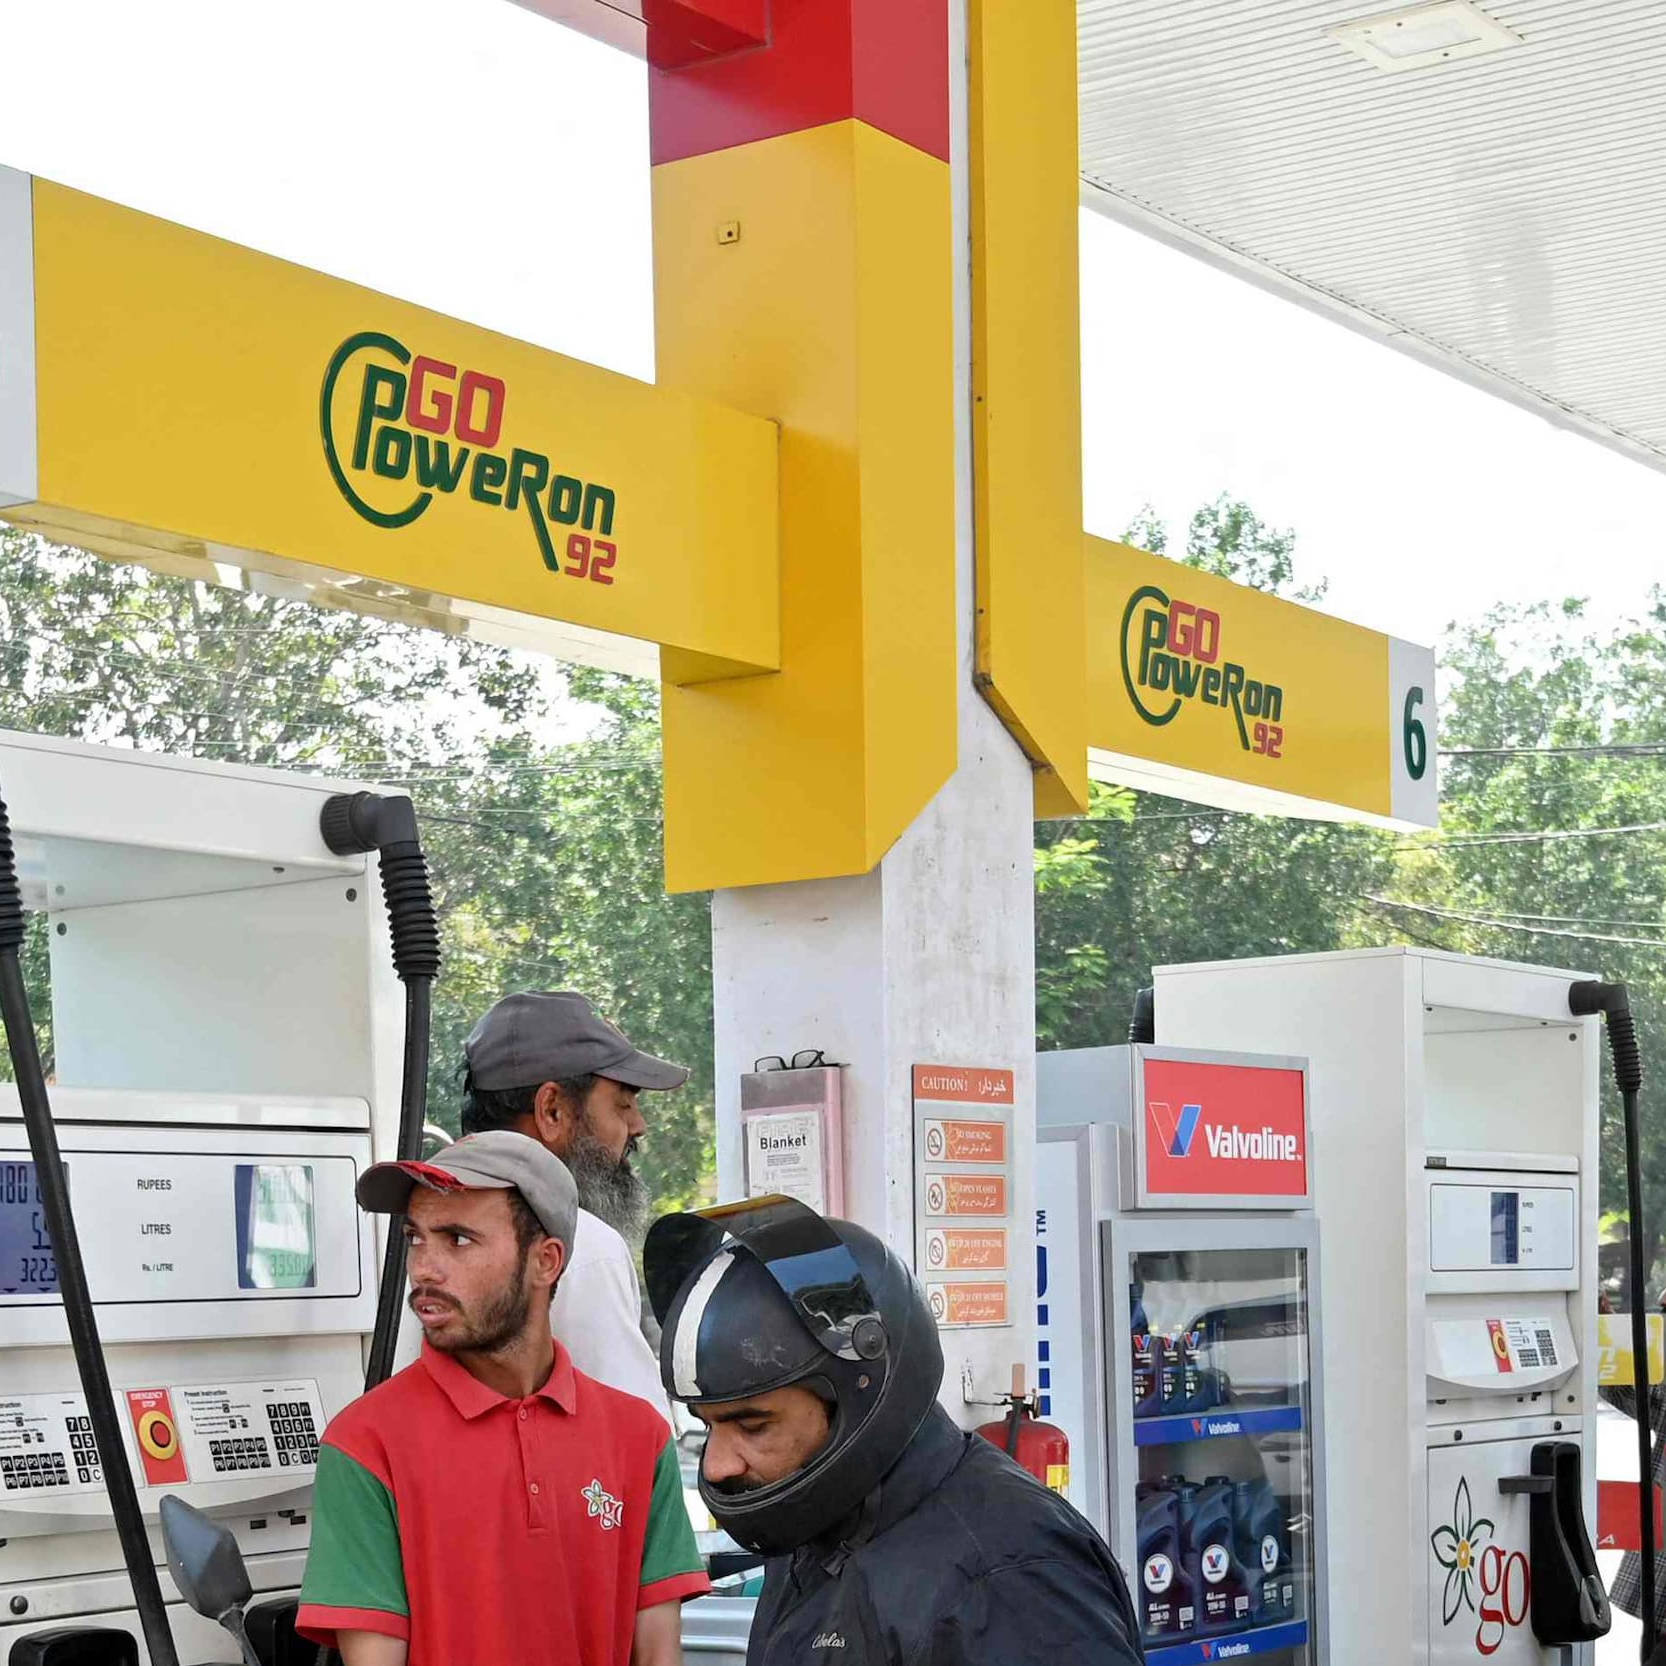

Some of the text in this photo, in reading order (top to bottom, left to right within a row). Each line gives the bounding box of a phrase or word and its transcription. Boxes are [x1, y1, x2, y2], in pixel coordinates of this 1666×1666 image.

[406, 355, 505, 450] GO
[564, 533, 617, 585] 92
[1167, 599, 1220, 664] GO
[1253, 722, 1283, 759] 92
[1403, 686, 1427, 781] 6
[921, 1076, 968, 1092] CAUTION!
[760, 1133, 807, 1150] Blanket
[137, 1179, 172, 1190] RUPEES
[141, 1223, 172, 1235] LITRES
[1036, 1210, 1046, 1236] TM
[156, 1263, 174, 1271] LITRE
[2, 1459, 13, 1470] P1
[14, 1458, 26, 1469] P2
[40, 1456, 52, 1466] P4
[18, 1475, 30, 1486] P7
[1475, 1544, 1530, 1656] go
